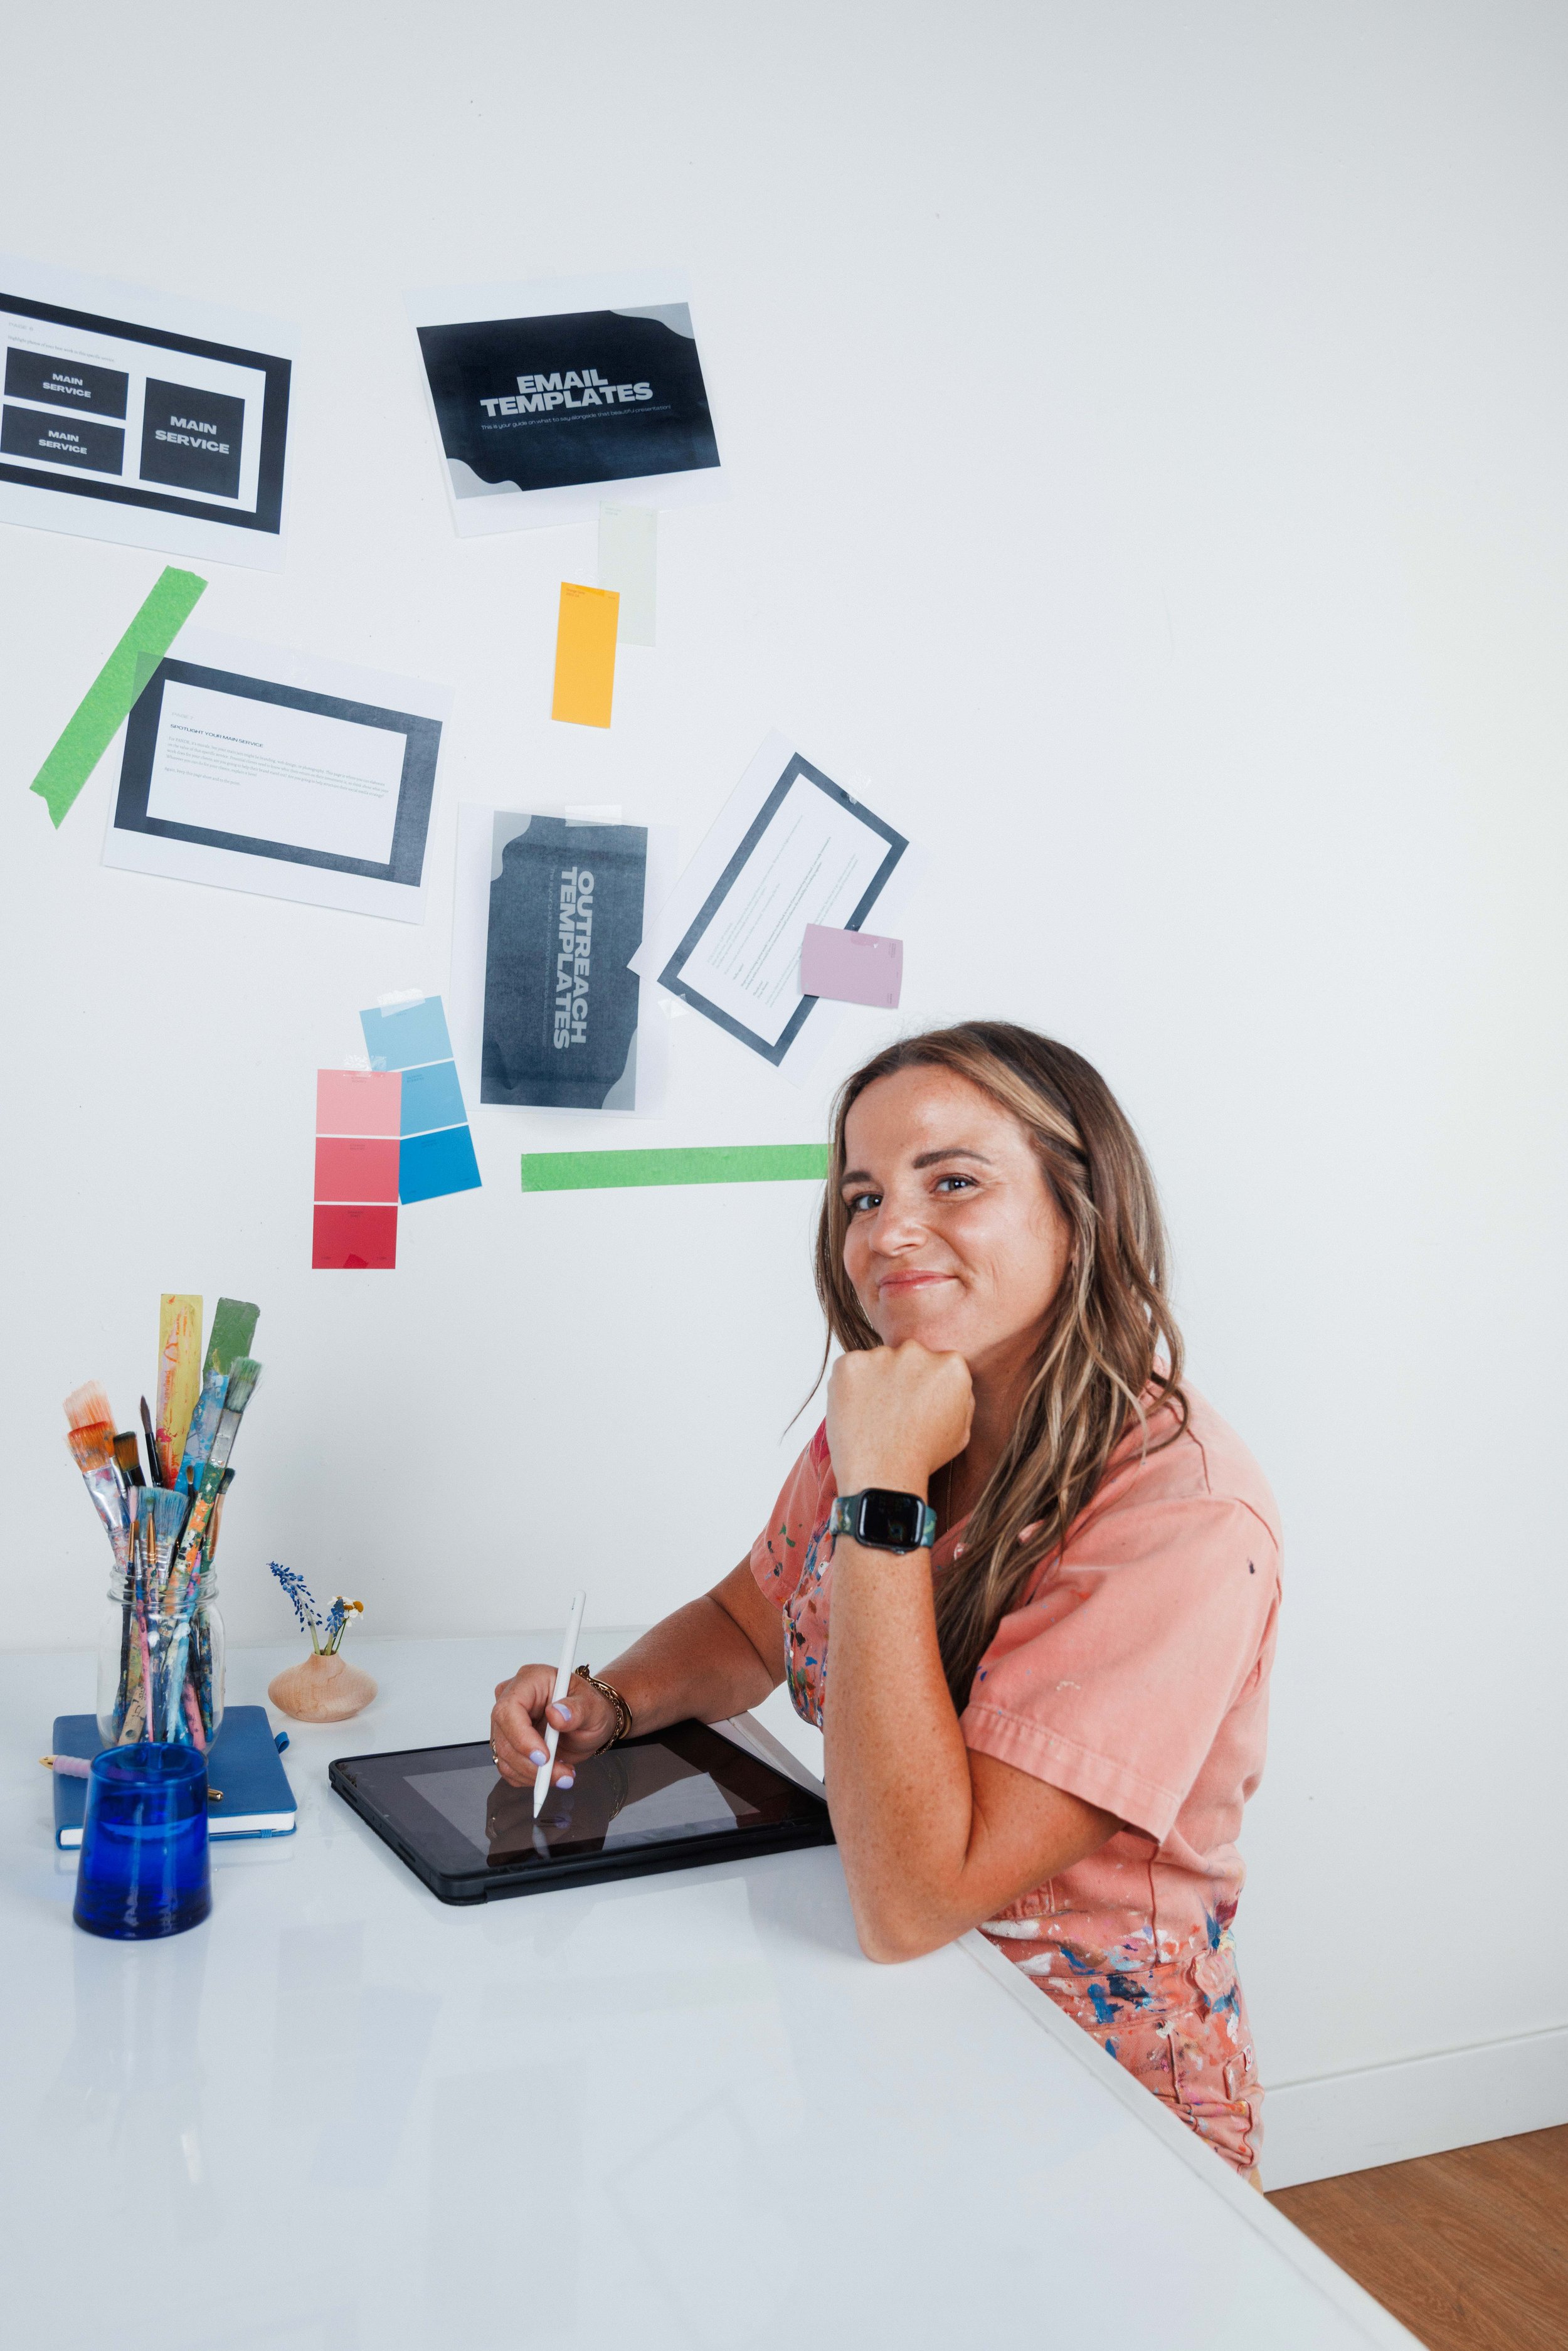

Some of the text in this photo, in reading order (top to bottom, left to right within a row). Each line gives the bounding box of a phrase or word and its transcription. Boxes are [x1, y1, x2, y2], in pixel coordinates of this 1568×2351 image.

[43, 382, 91, 398] SERVICE
[53, 374, 83, 386] MAIN
[517, 369, 608, 395] EMAIL
[480, 383, 653, 417] TEMPLATES
[171, 416, 216, 435] MAIN
[571, 412, 596, 421] alongside
[39, 439, 87, 454] SERVICE
[48, 430, 78, 442] MAIN
[156, 430, 229, 454] SERVICE
[171, 723, 203, 735] SPOTLIGHT
[238, 738, 263, 748] SERVICE
[554, 866, 578, 1049] TEMPLATES
[571, 871, 595, 1043] OUTREACH
